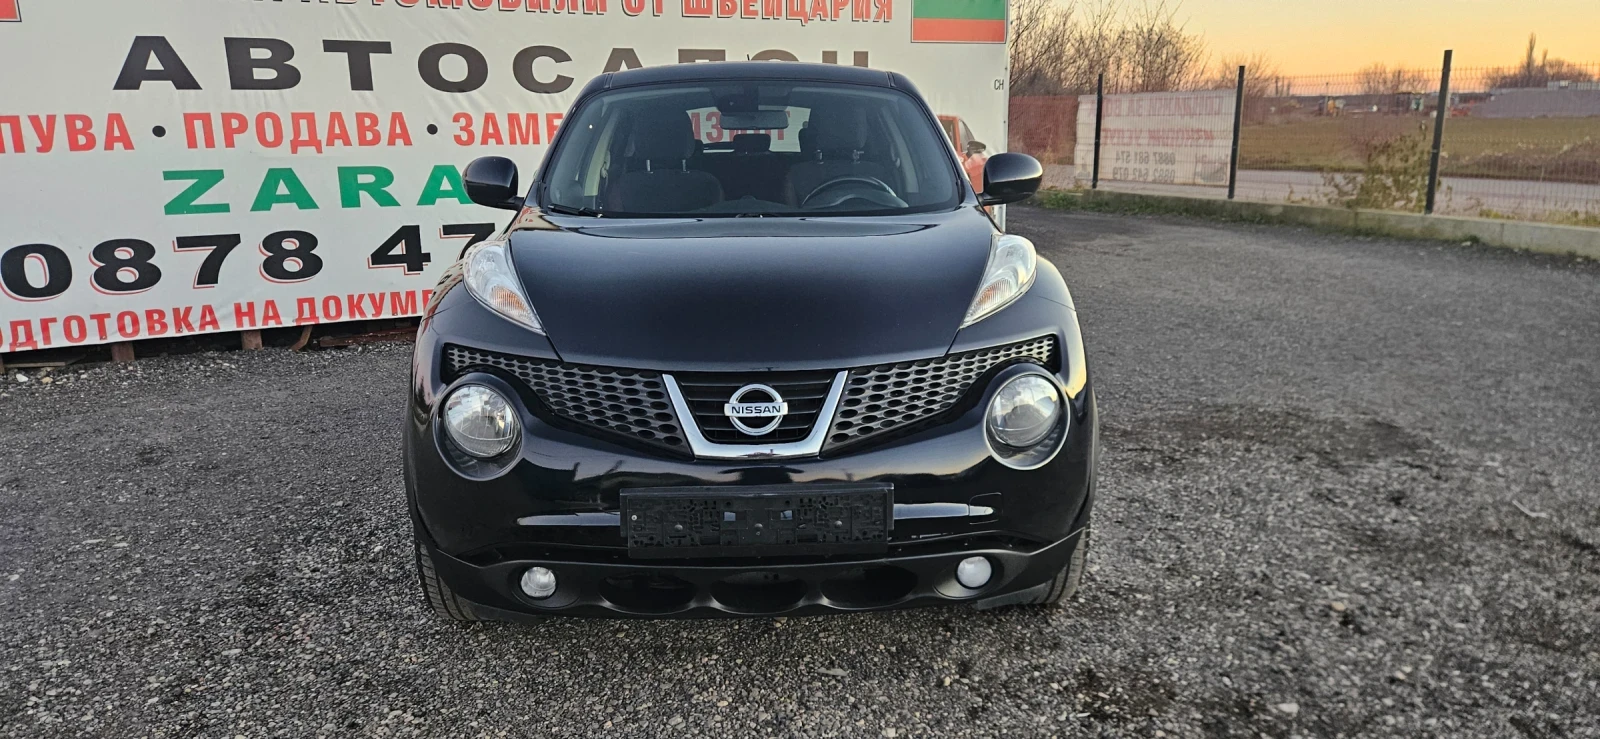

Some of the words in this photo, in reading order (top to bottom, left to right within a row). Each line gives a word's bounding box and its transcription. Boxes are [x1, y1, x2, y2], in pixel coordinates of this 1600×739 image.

[113, 36, 869, 93] АВТОСА
[183, 112, 413, 154] ПРОДАВА
[162, 164, 474, 215] ZARA
[1, 230, 324, 302] 0878
[0, 304, 220, 351] ДГОТОВКА
[234, 299, 282, 328] НА
[731, 405, 781, 413] NISSAN
